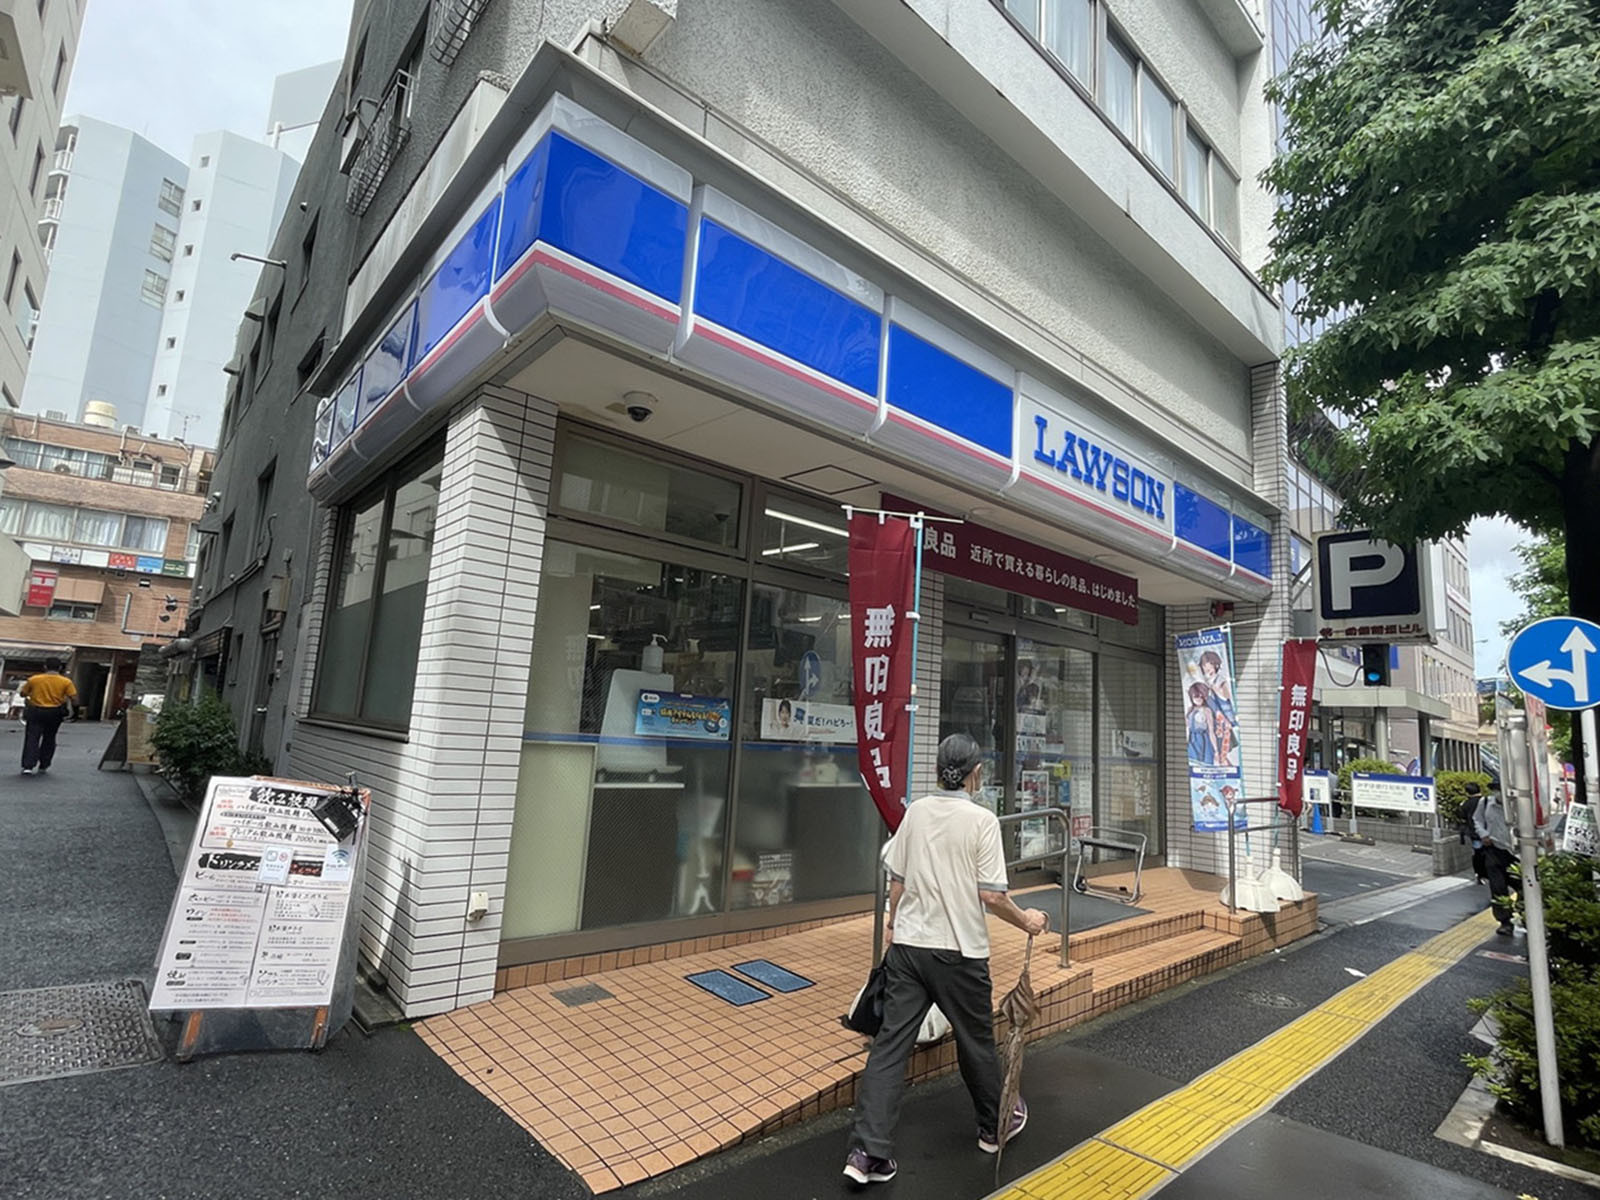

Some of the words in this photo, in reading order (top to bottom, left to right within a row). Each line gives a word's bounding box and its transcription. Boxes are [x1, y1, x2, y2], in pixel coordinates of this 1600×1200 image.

[1034, 414, 1166, 521] LAWSON
[1329, 538, 1405, 611] P
[1286, 684, 1307, 780] 無印良品
